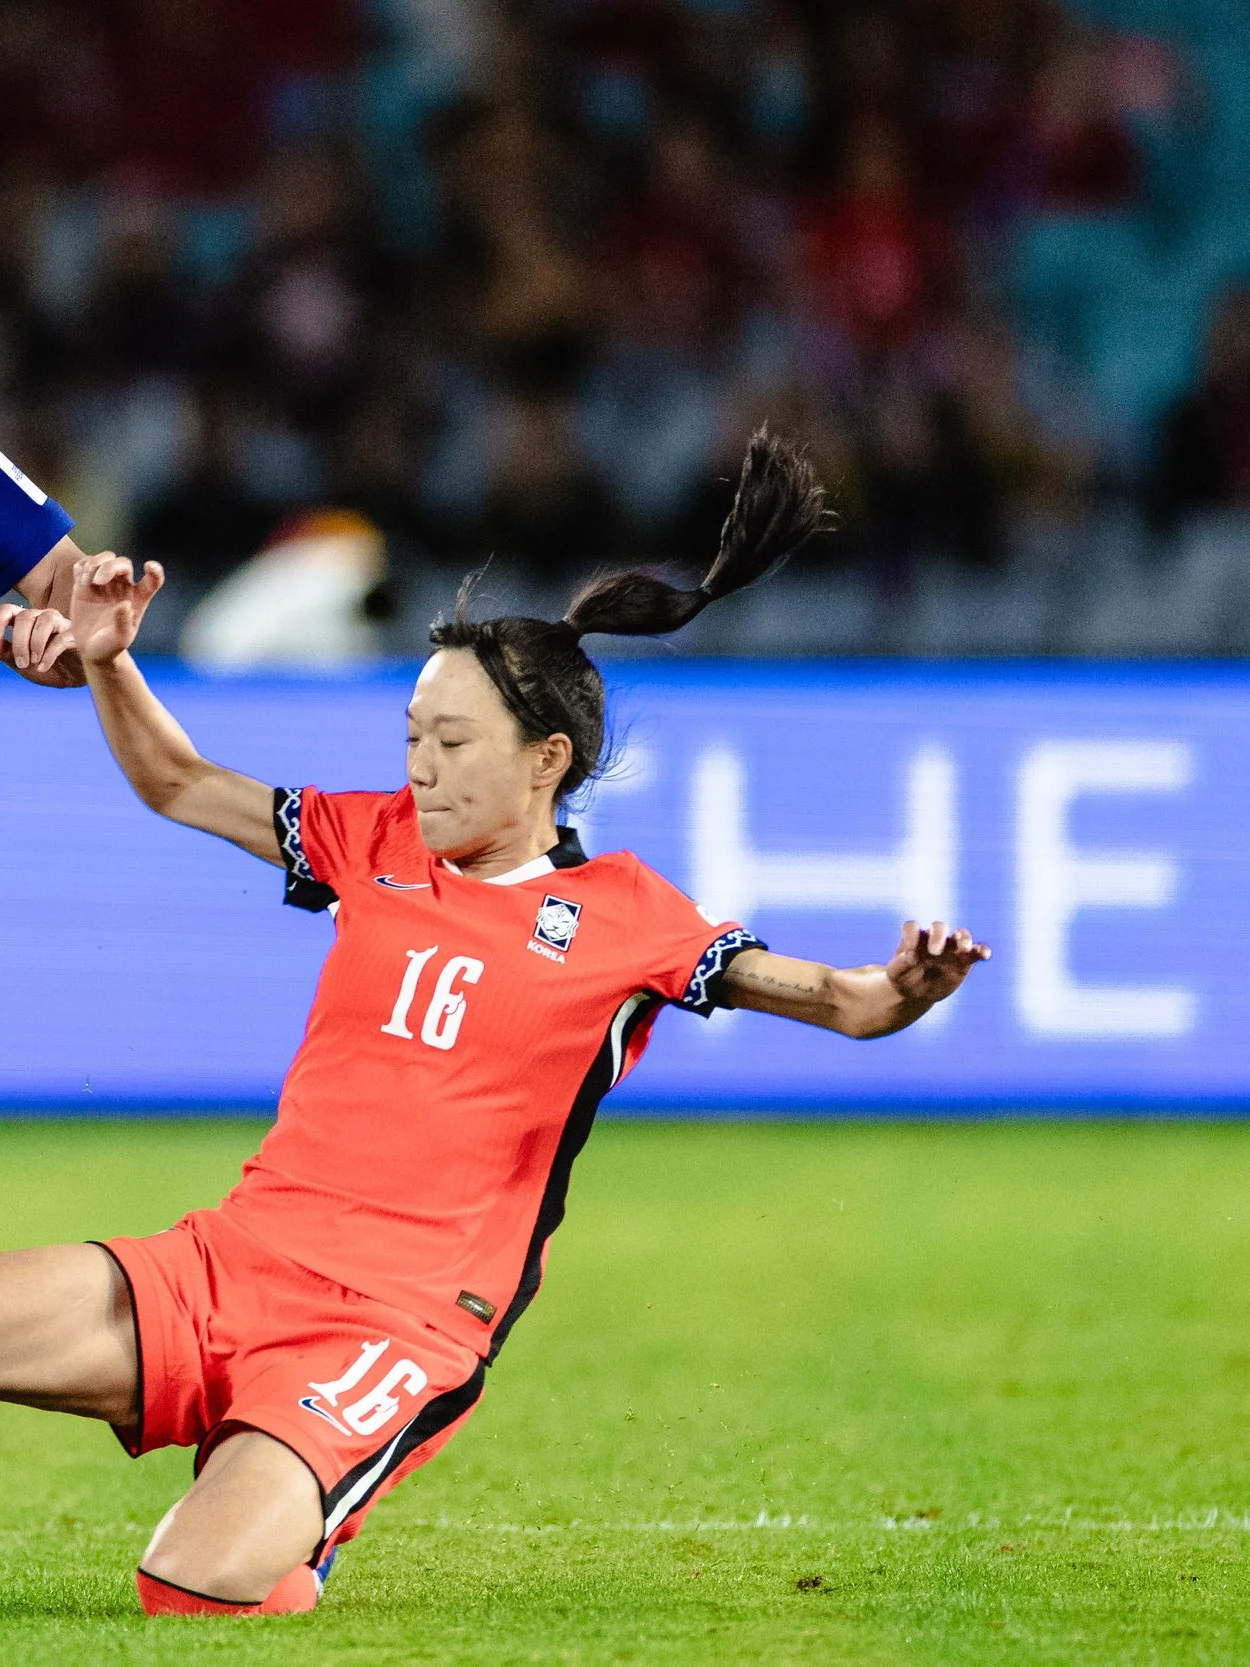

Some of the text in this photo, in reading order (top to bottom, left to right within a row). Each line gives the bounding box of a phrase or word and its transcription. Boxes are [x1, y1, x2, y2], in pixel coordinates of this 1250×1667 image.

[568, 738, 1192, 1042] HE
[380, 944, 485, 1051] 16
[526, 941, 566, 964] KOREA
[307, 1338, 428, 1435] 16
